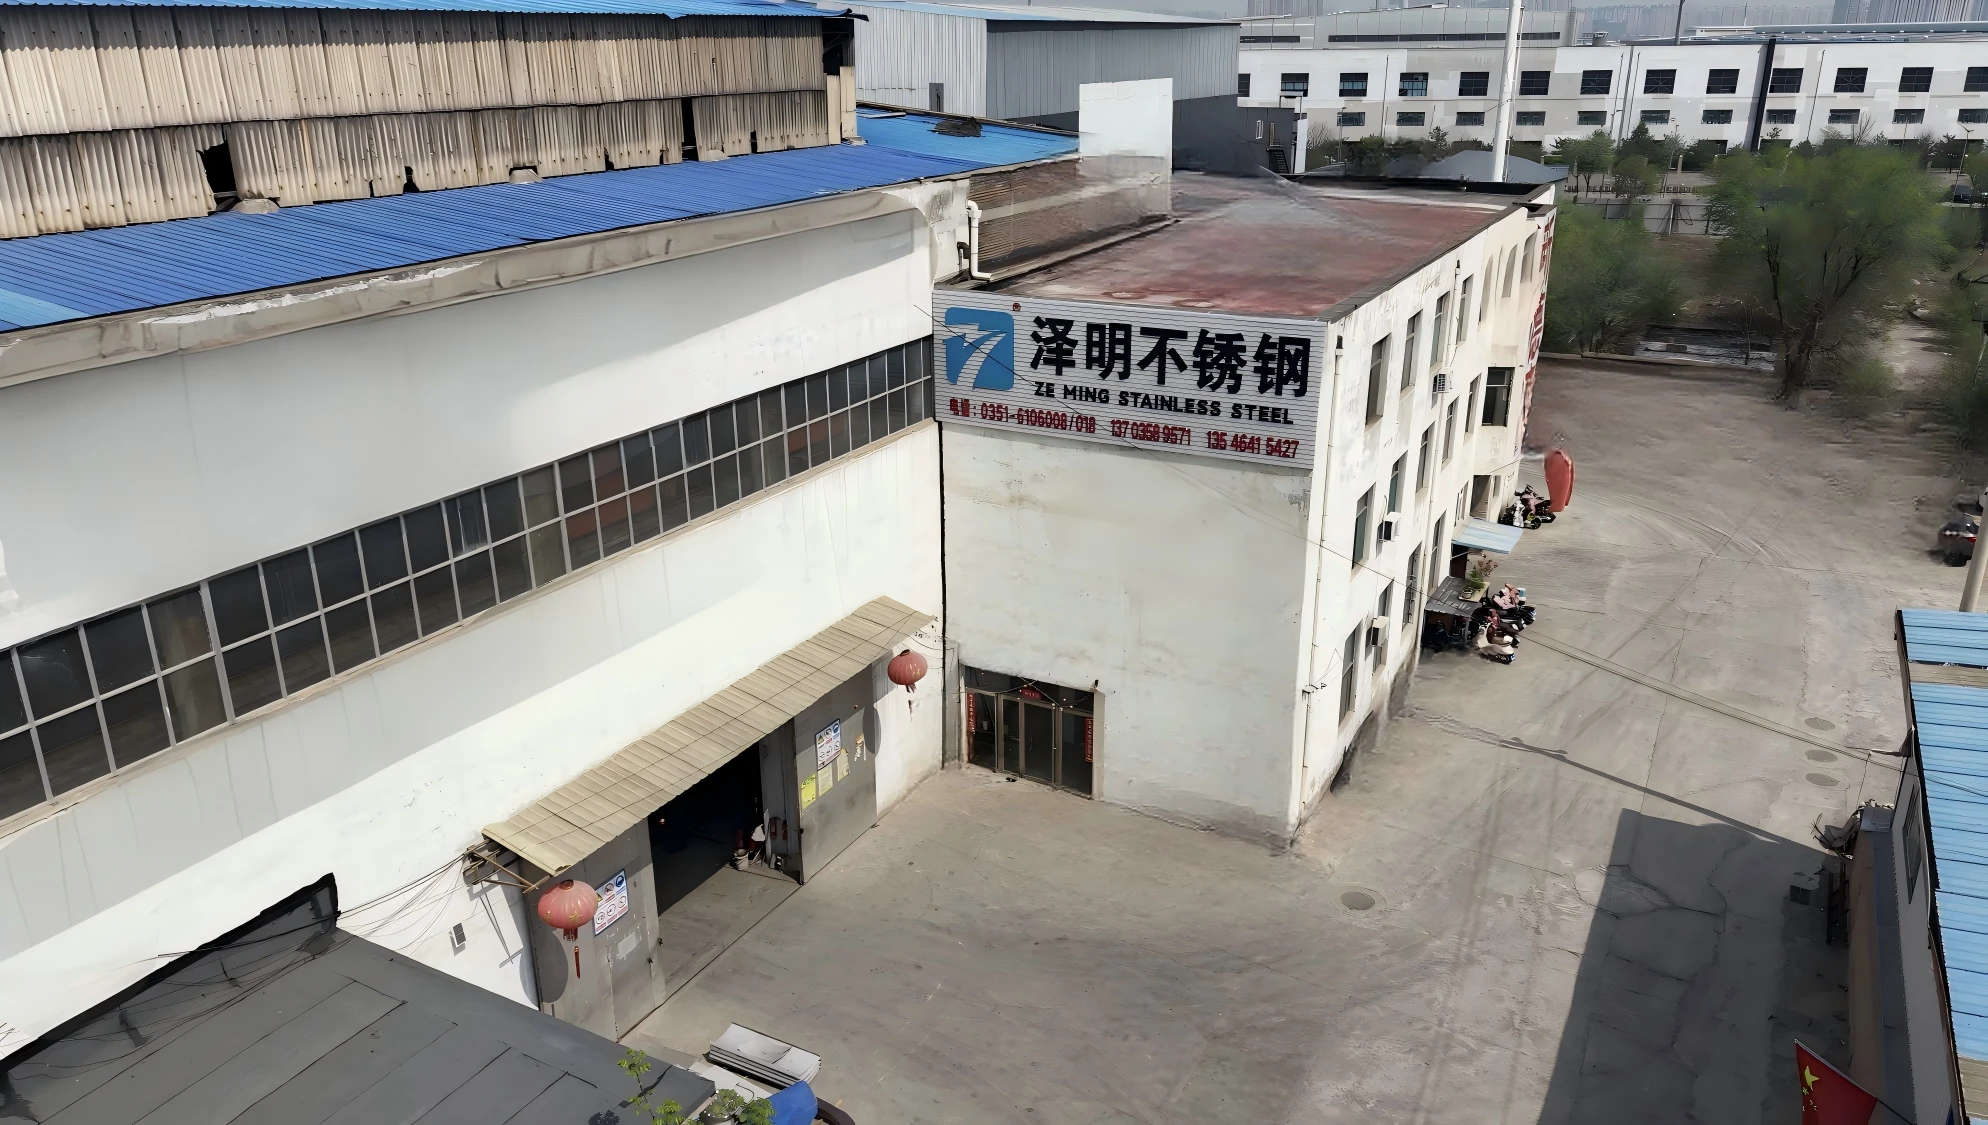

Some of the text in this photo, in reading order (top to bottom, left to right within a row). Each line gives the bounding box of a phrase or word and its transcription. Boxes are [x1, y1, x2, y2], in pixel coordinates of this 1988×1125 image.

[1030, 315, 1311, 397] 泽明不锈钢
[1034, 381, 1294, 425] ZE MING STAINLESS STEEL
